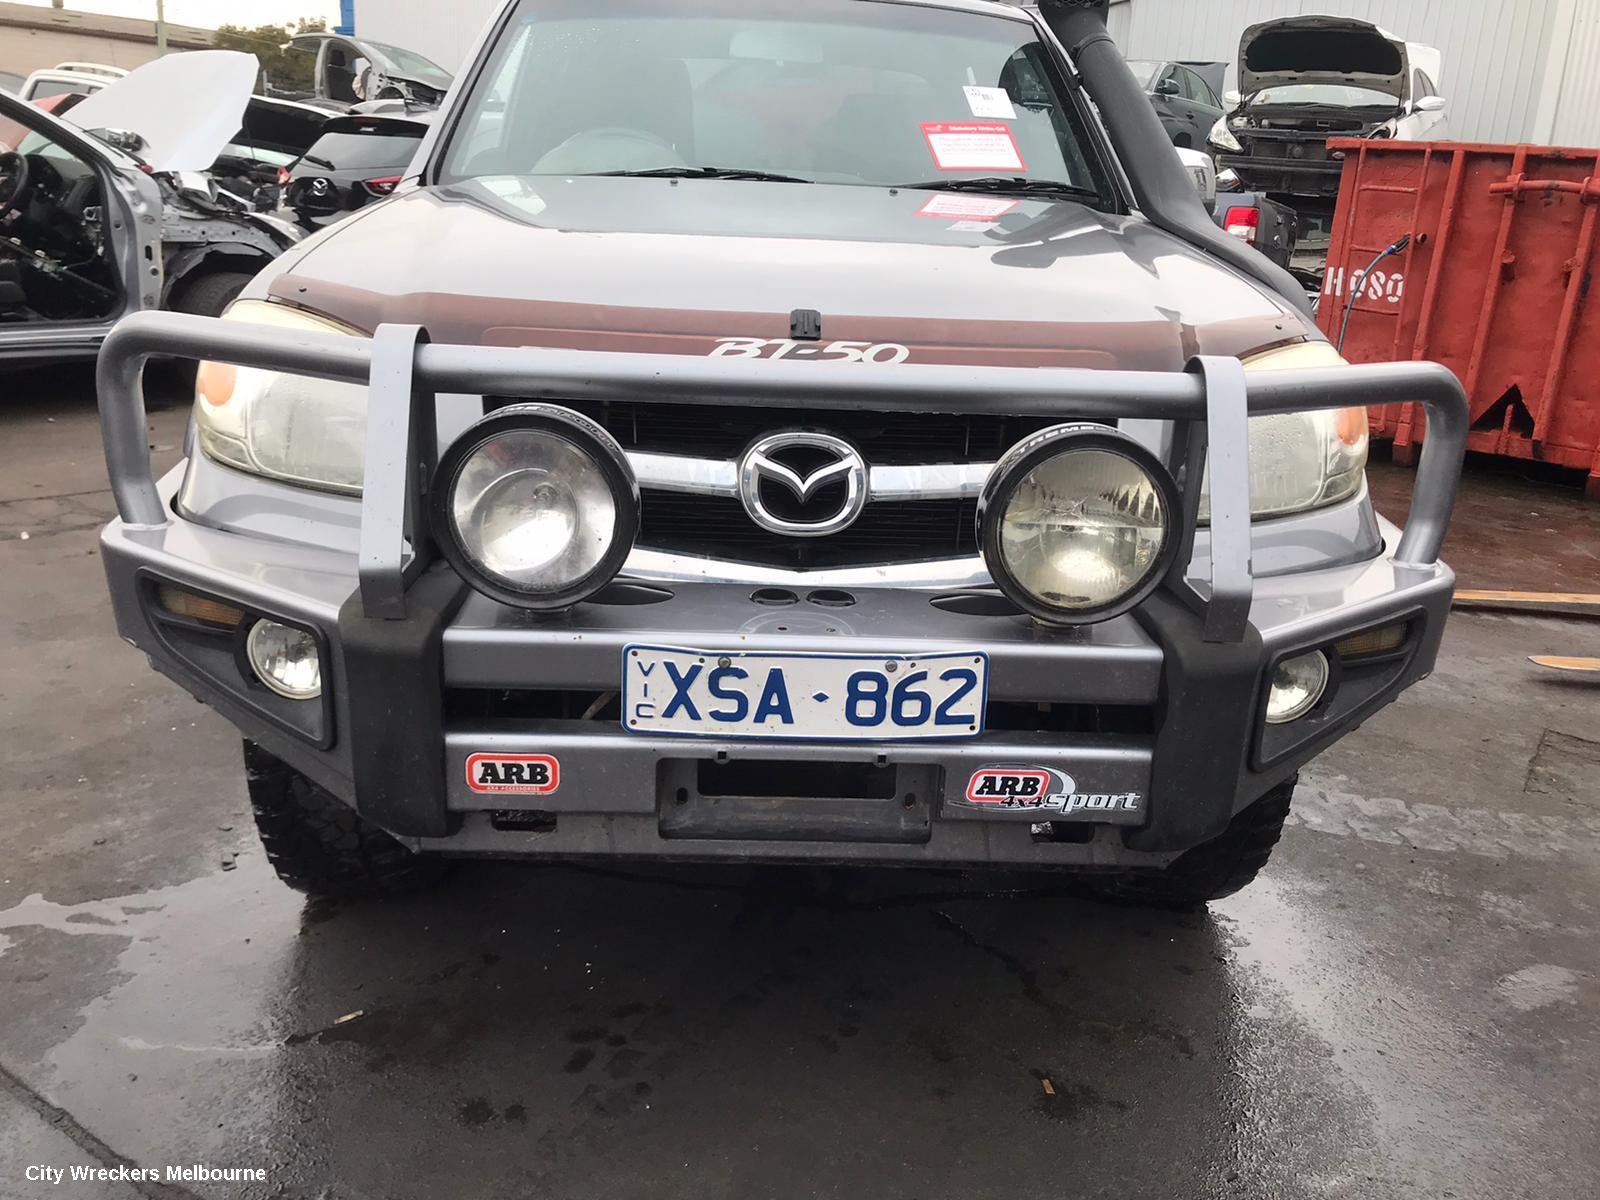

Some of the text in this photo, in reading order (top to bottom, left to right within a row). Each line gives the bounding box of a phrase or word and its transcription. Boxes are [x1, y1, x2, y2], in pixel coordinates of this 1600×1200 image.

[707, 337, 910, 364] BT-50
[636, 660, 657, 719] VIC
[478, 762, 549, 784] ARB
[975, 776, 1041, 796] ARB
